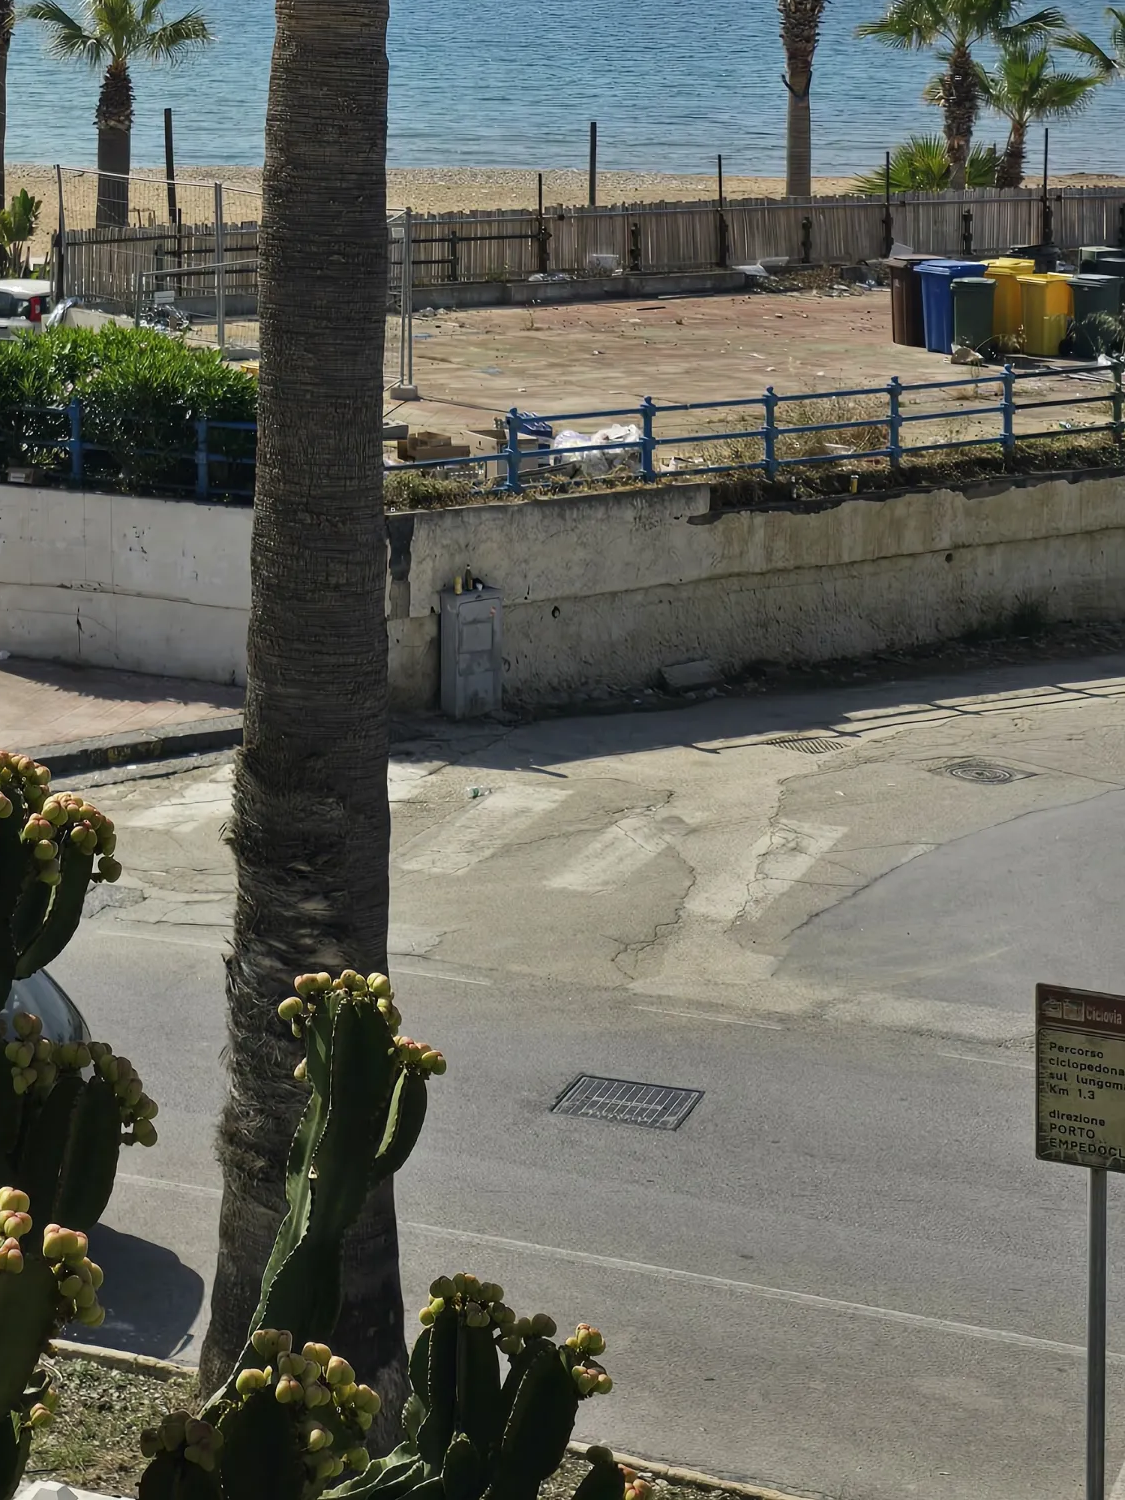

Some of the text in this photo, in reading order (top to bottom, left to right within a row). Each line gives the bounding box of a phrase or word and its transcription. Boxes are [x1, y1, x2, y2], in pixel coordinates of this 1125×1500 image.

[1086, 1005, 1123, 1025] Ciclovia
[1049, 1042, 1104, 1059] Percorso
[1049, 1072, 1125, 1091] sul lungam
[1049, 1084, 1095, 1100] Km 1.3
[1049, 1110, 1106, 1127] direzione
[1049, 1123, 1096, 1139] PORTO
